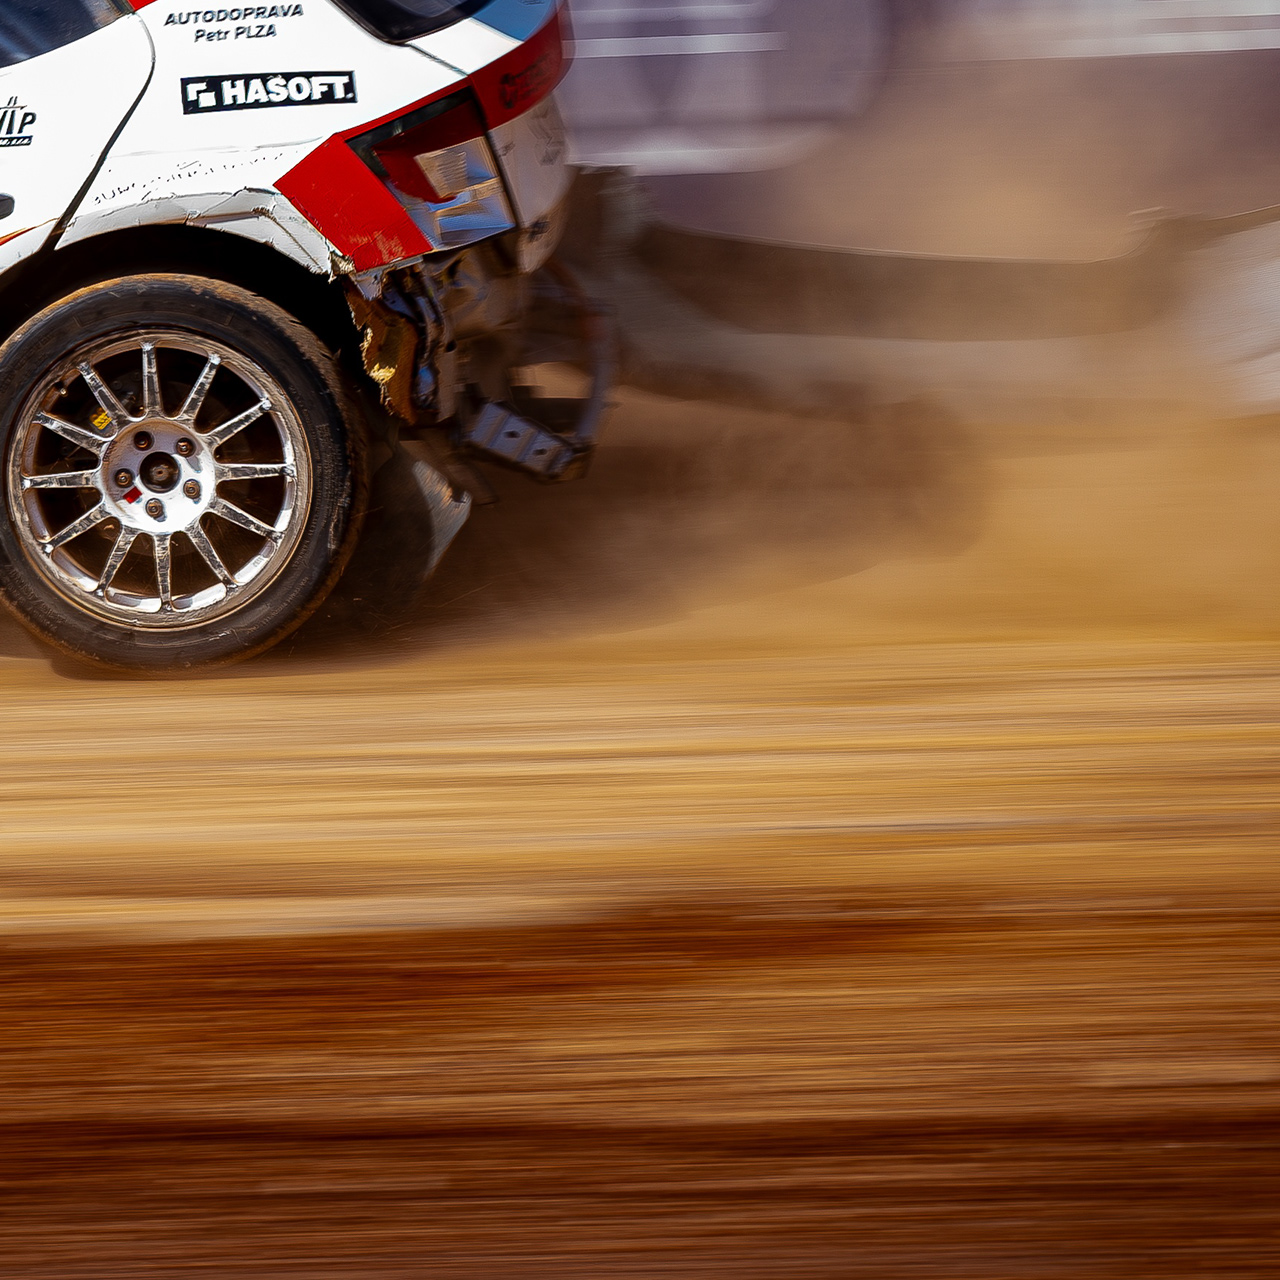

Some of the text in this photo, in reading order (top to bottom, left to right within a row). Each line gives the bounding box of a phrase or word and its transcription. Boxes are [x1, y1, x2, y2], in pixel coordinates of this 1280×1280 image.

[164, 4, 304, 26] AUTODOPRAVA
[194, 24, 278, 43] Petr PLZA
